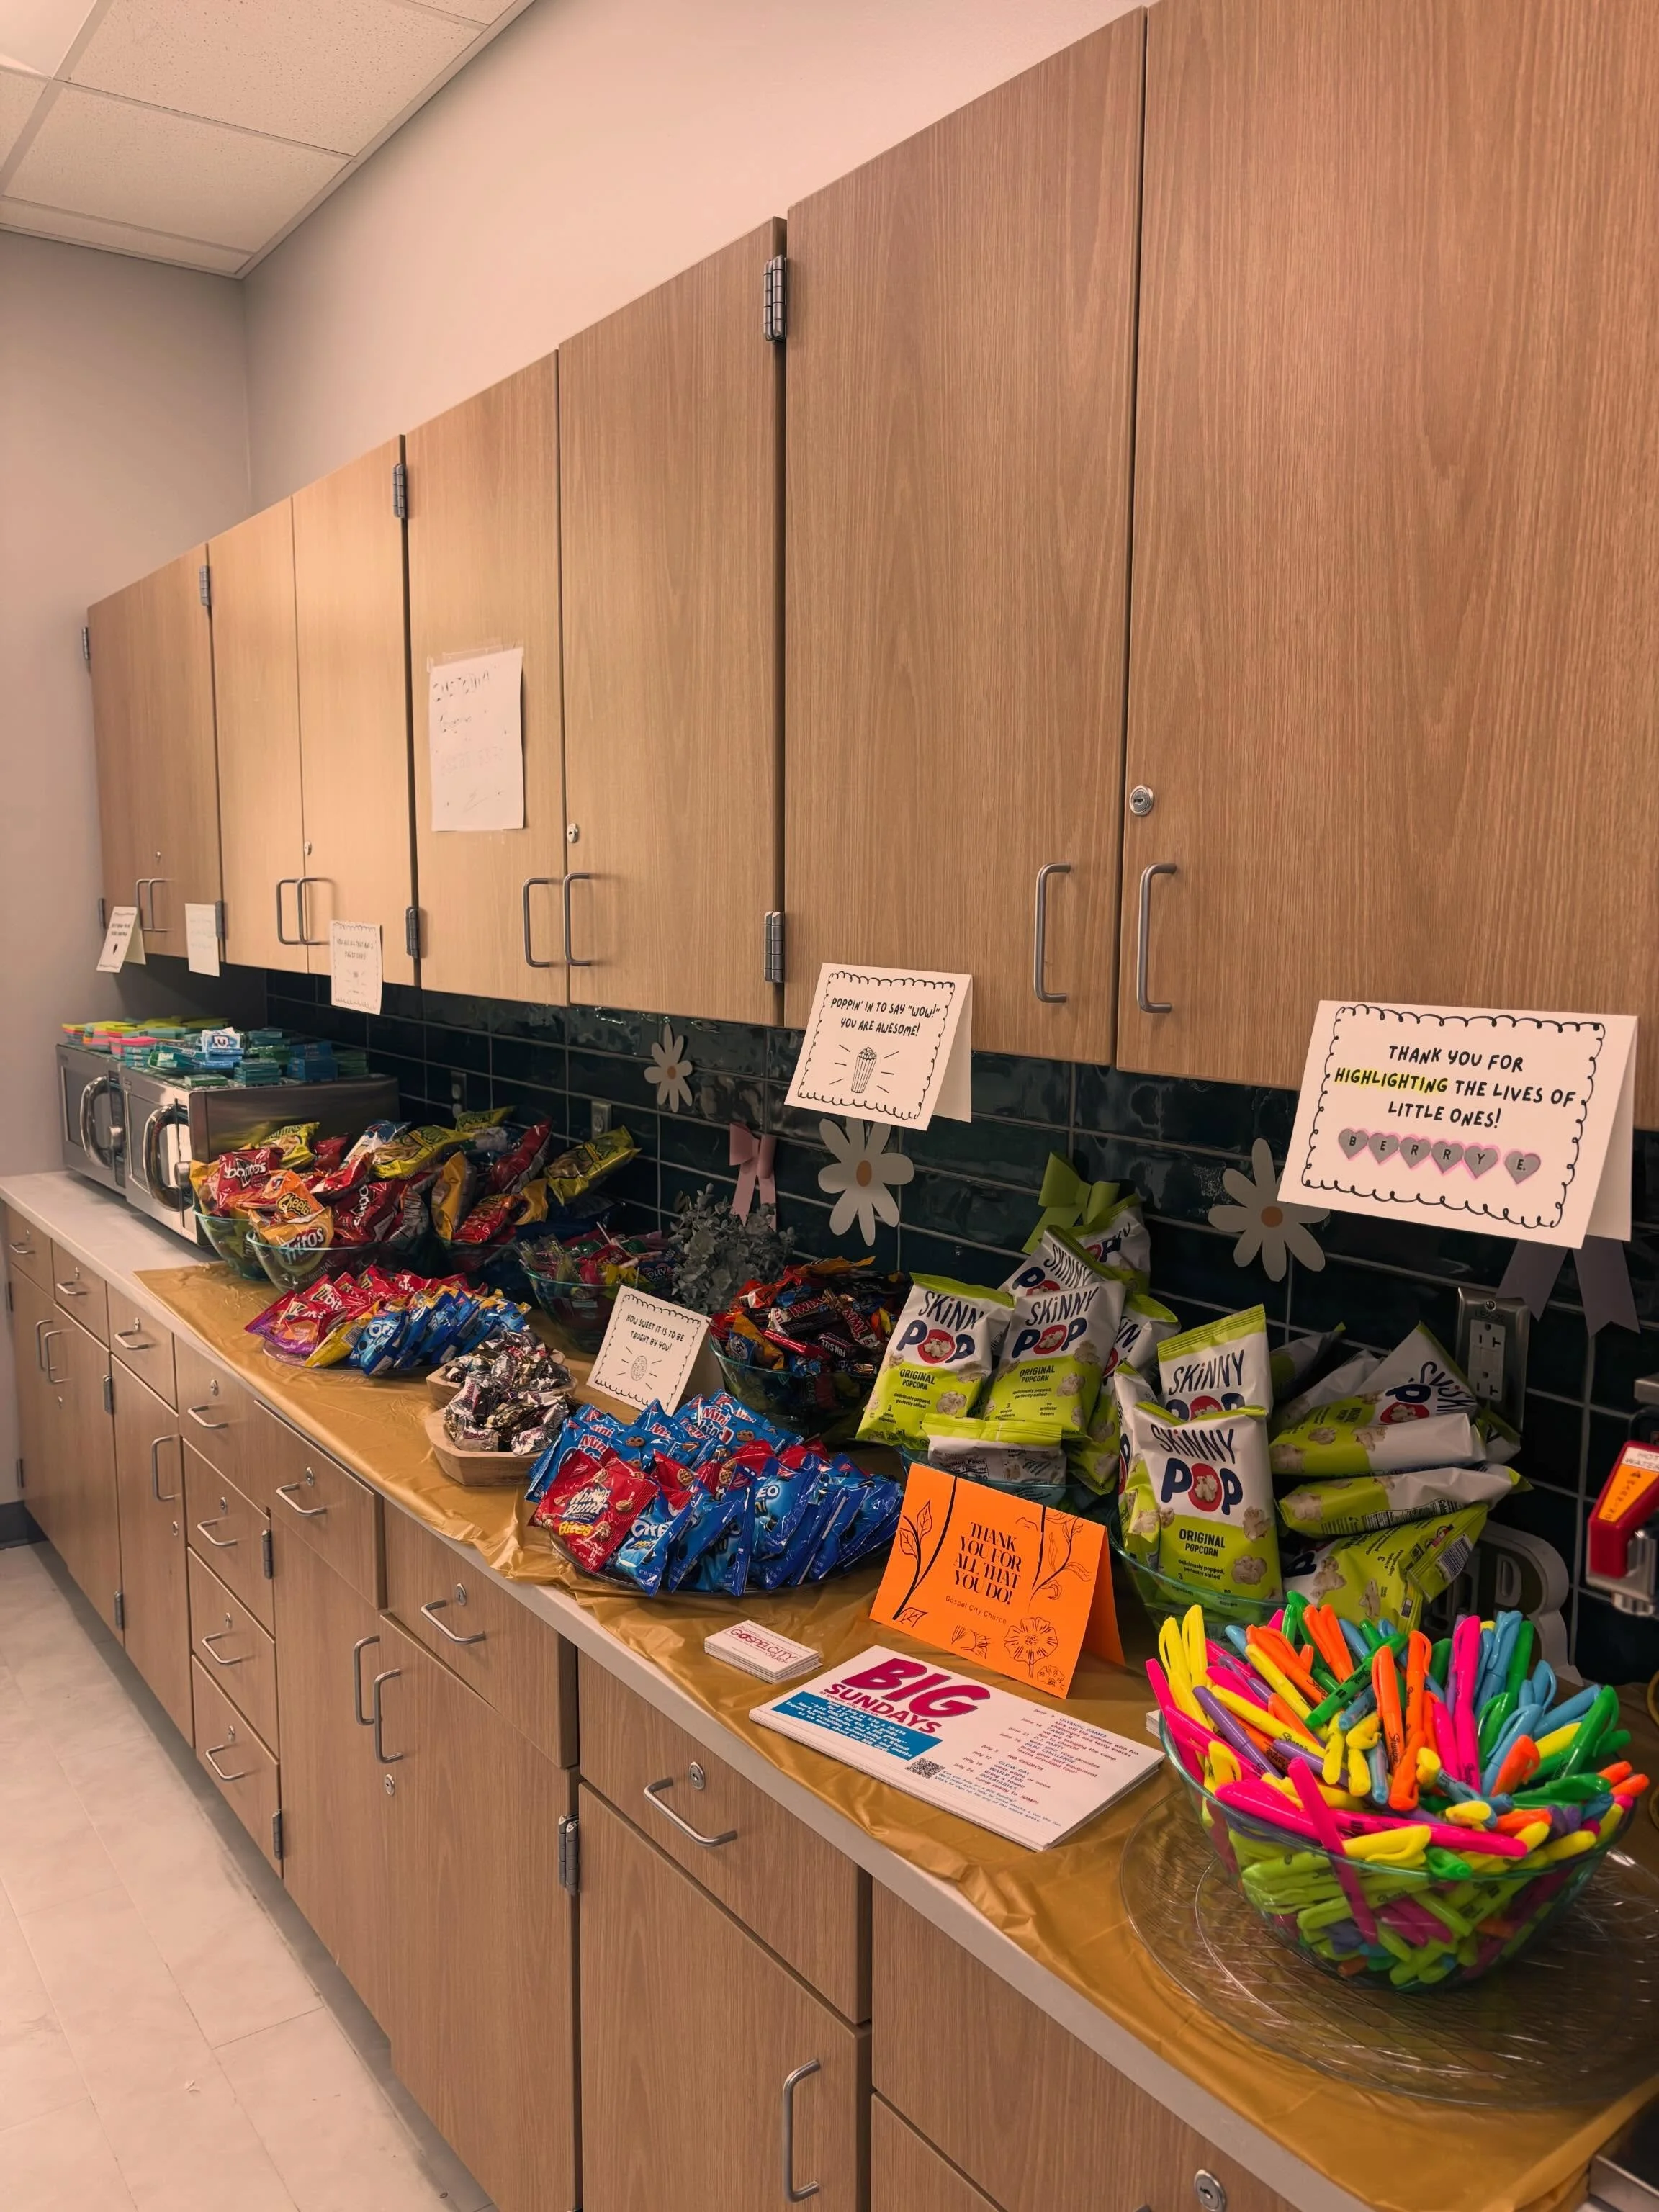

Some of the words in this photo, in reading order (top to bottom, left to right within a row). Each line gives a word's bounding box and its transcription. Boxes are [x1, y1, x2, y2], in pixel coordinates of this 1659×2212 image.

[831, 997, 863, 1011] POPPIN'
[864, 1002, 873, 1012] IN
[876, 1002, 886, 1012] TO
[889, 1003, 905, 1015] SAY
[908, 1004, 940, 1018] "WOW!"
[840, 1017, 857, 1028] YOU
[858, 1020, 873, 1031] ARE
[875, 1022, 920, 1037] AWESOME!
[1388, 1045, 1442, 1064] THANK
[1447, 1050, 1483, 1067] YOU
[1487, 1054, 1524, 1072] FOR
[1334, 1067, 1449, 1094] HIGHLIGHTING
[1455, 1079, 1485, 1097] THE
[1493, 1084, 1543, 1104] LIVES
[1550, 1088, 1576, 1107] OF
[1388, 1101, 1443, 1121] LITTLE
[1449, 1107, 1502, 1129] ONES!
[626, 1313, 638, 1326] HOW
[638, 1318, 655, 1331] SWEET
[661, 1326, 667, 1335] IS
[667, 1328, 675, 1339] TO
[675, 1332, 685, 1342] BE
[1011, 1317, 1088, 1359] POP
[630, 1330, 649, 1344] TAUGHT
[649, 1338, 658, 1346] BY
[658, 1341, 673, 1353] YOU!
[896, 1319, 976, 1364] POP
[899, 1368, 936, 1385] ORIGINAL
[1020, 1364, 1055, 1377] ORIGINAL
[1021, 1375, 1050, 1383] POPCORN
[902, 1379, 928, 1390] POPCORN
[1161, 1457, 1244, 1516] POP
[971, 1521, 1017, 1552] THANK
[1179, 1528, 1226, 1549] ORIGINAL
[1184, 1542, 1219, 1557] POPCORN
[961, 1536, 991, 1559] YOU
[992, 1547, 1022, 1572] FOR
[1388, 1549, 1404, 1577] ingredients
[953, 1552, 980, 1575] ALL
[984, 1563, 1021, 1589] THAT
[955, 1570, 985, 1593] YOU
[985, 1582, 1013, 1605] DO!
[945, 1595, 968, 1609] Gospel
[968, 1604, 982, 1615] City
[984, 1611, 1007, 1624] Church
[840, 1658, 991, 1719] BIG
[823, 1683, 943, 1734] SUNDAYS
[997, 1761, 1017, 1769] GLOW
[1017, 1759, 1044, 1770] CHURCH
[1041, 1749, 1075, 1763] CHALLENGE
[979, 1773, 1017, 1790] INFLATABLES
